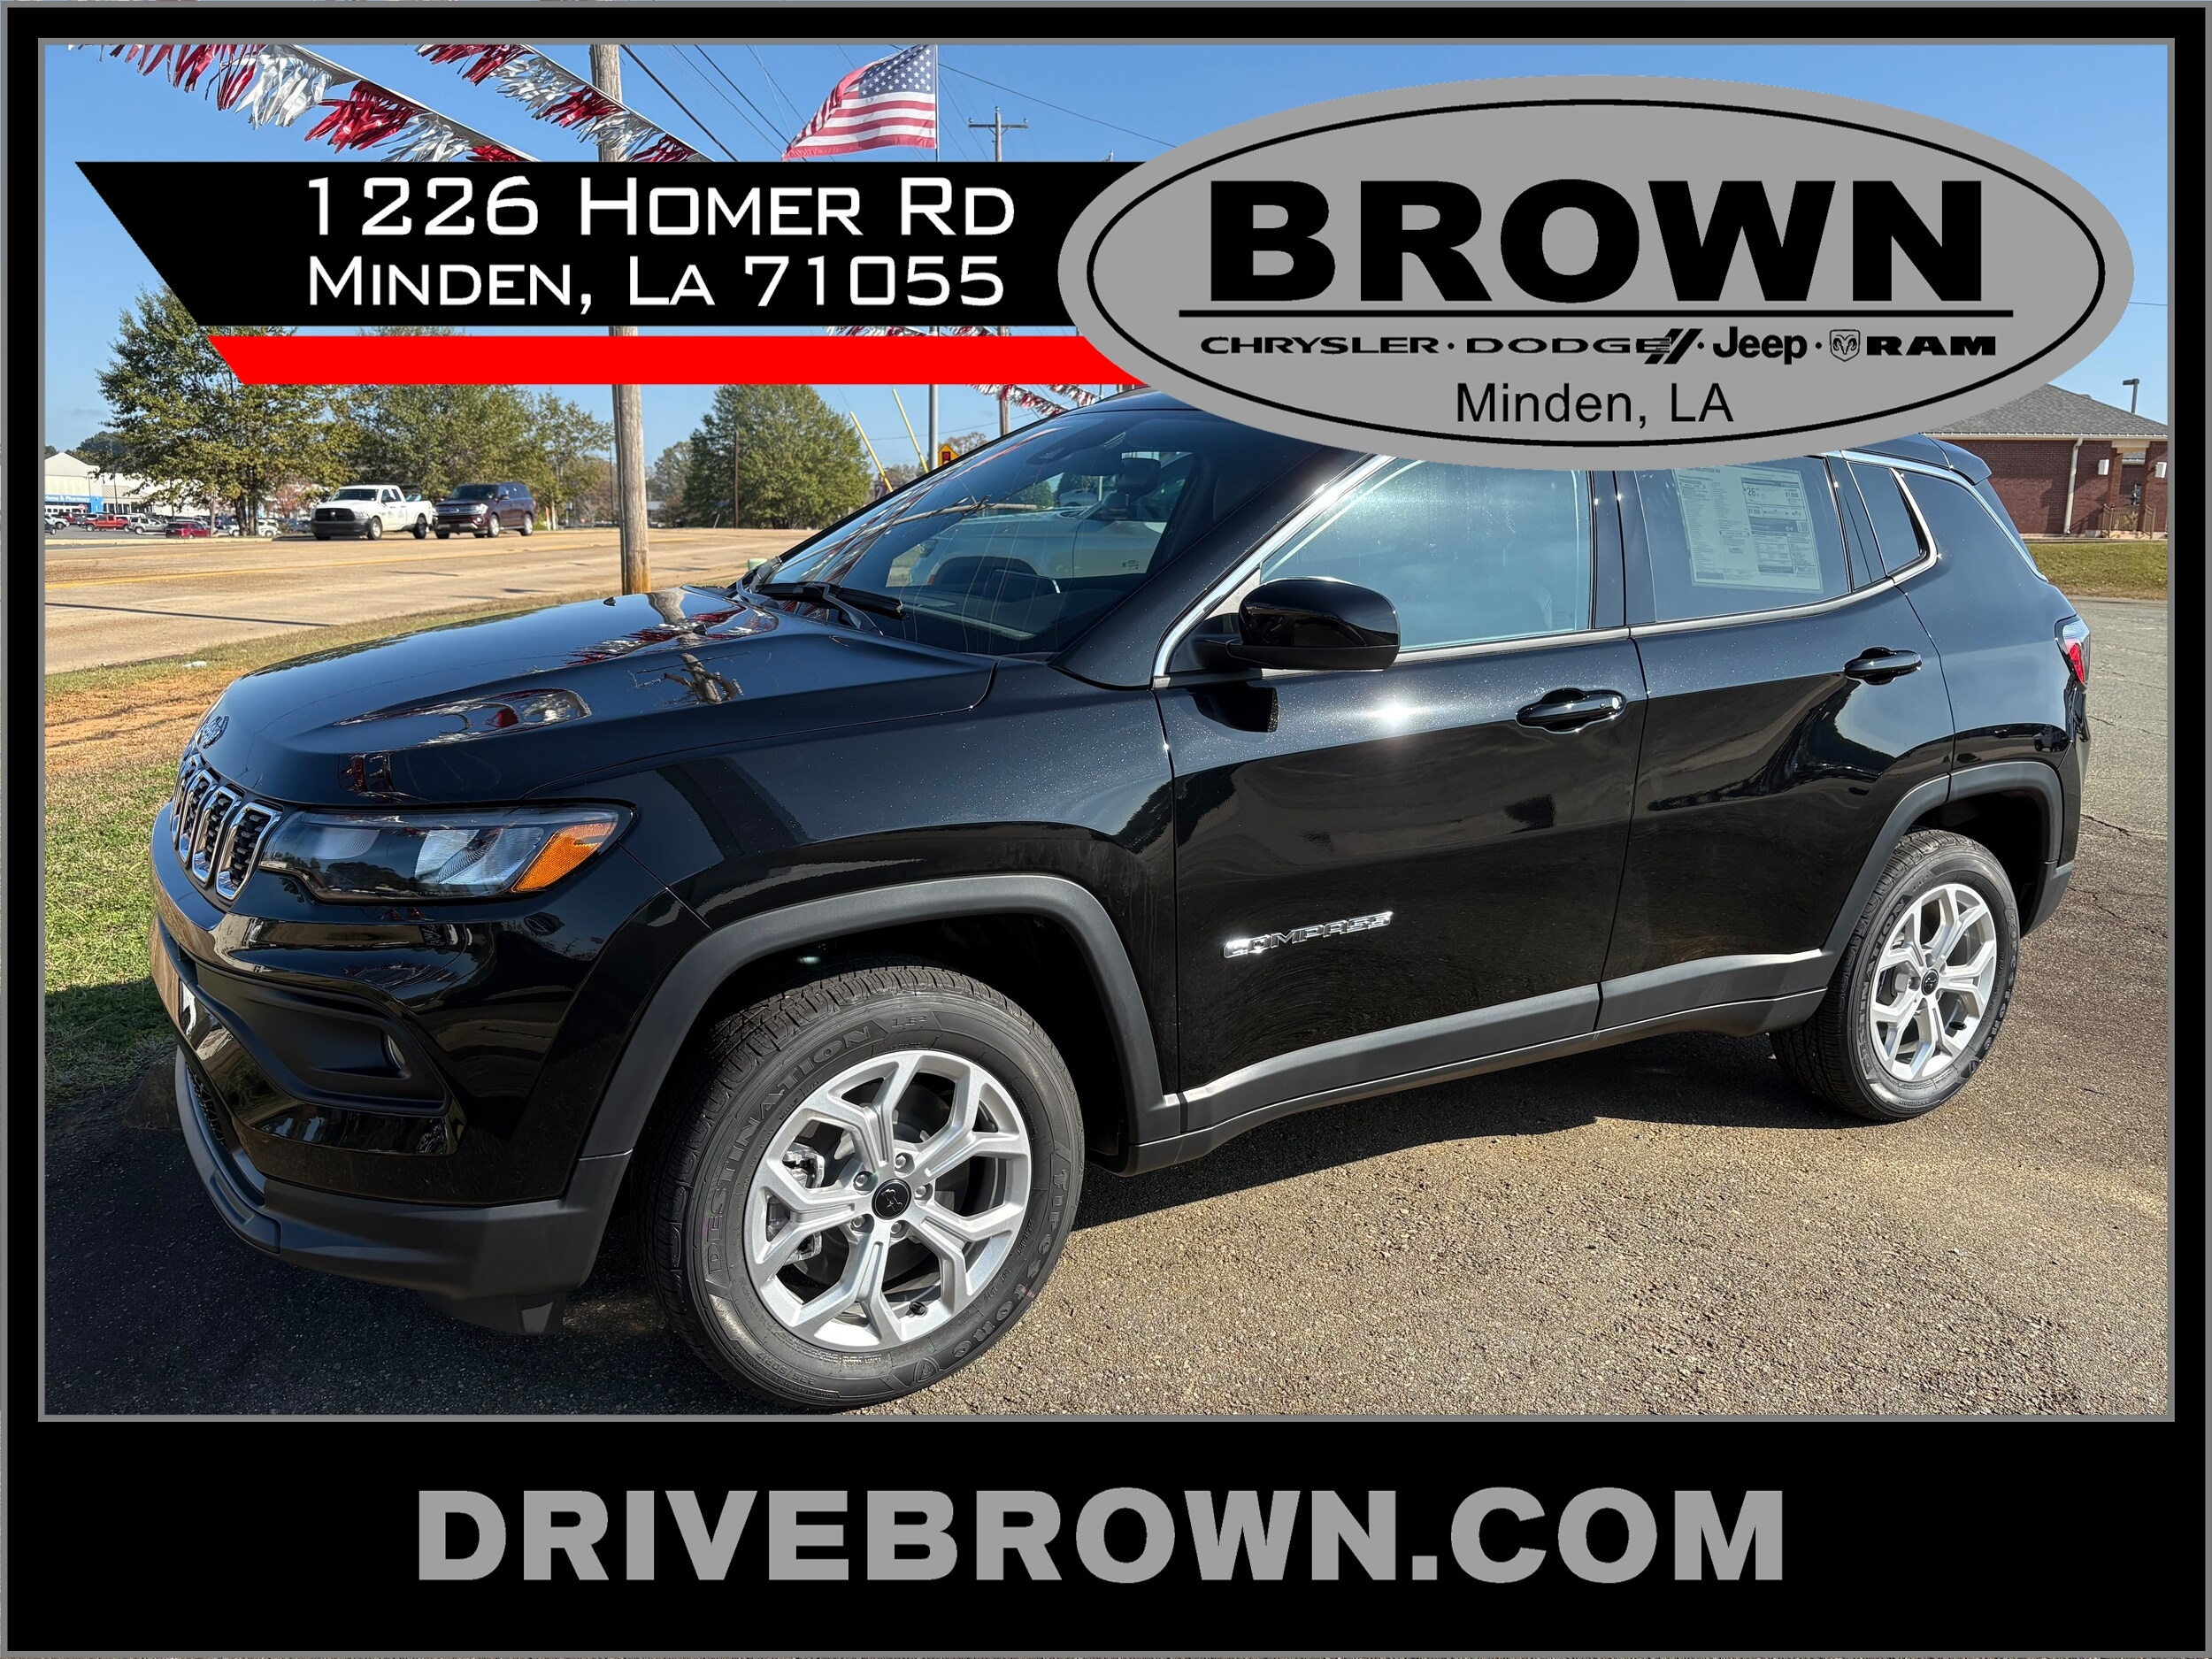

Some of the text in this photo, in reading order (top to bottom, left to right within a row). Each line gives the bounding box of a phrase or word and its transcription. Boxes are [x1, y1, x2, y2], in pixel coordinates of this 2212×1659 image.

[1747, 487, 1756, 497] 26
[1223, 910, 1394, 959] COMPASS
[706, 1025, 872, 1275] DESTINATION
[952, 1168, 1070, 1358] Firestone
